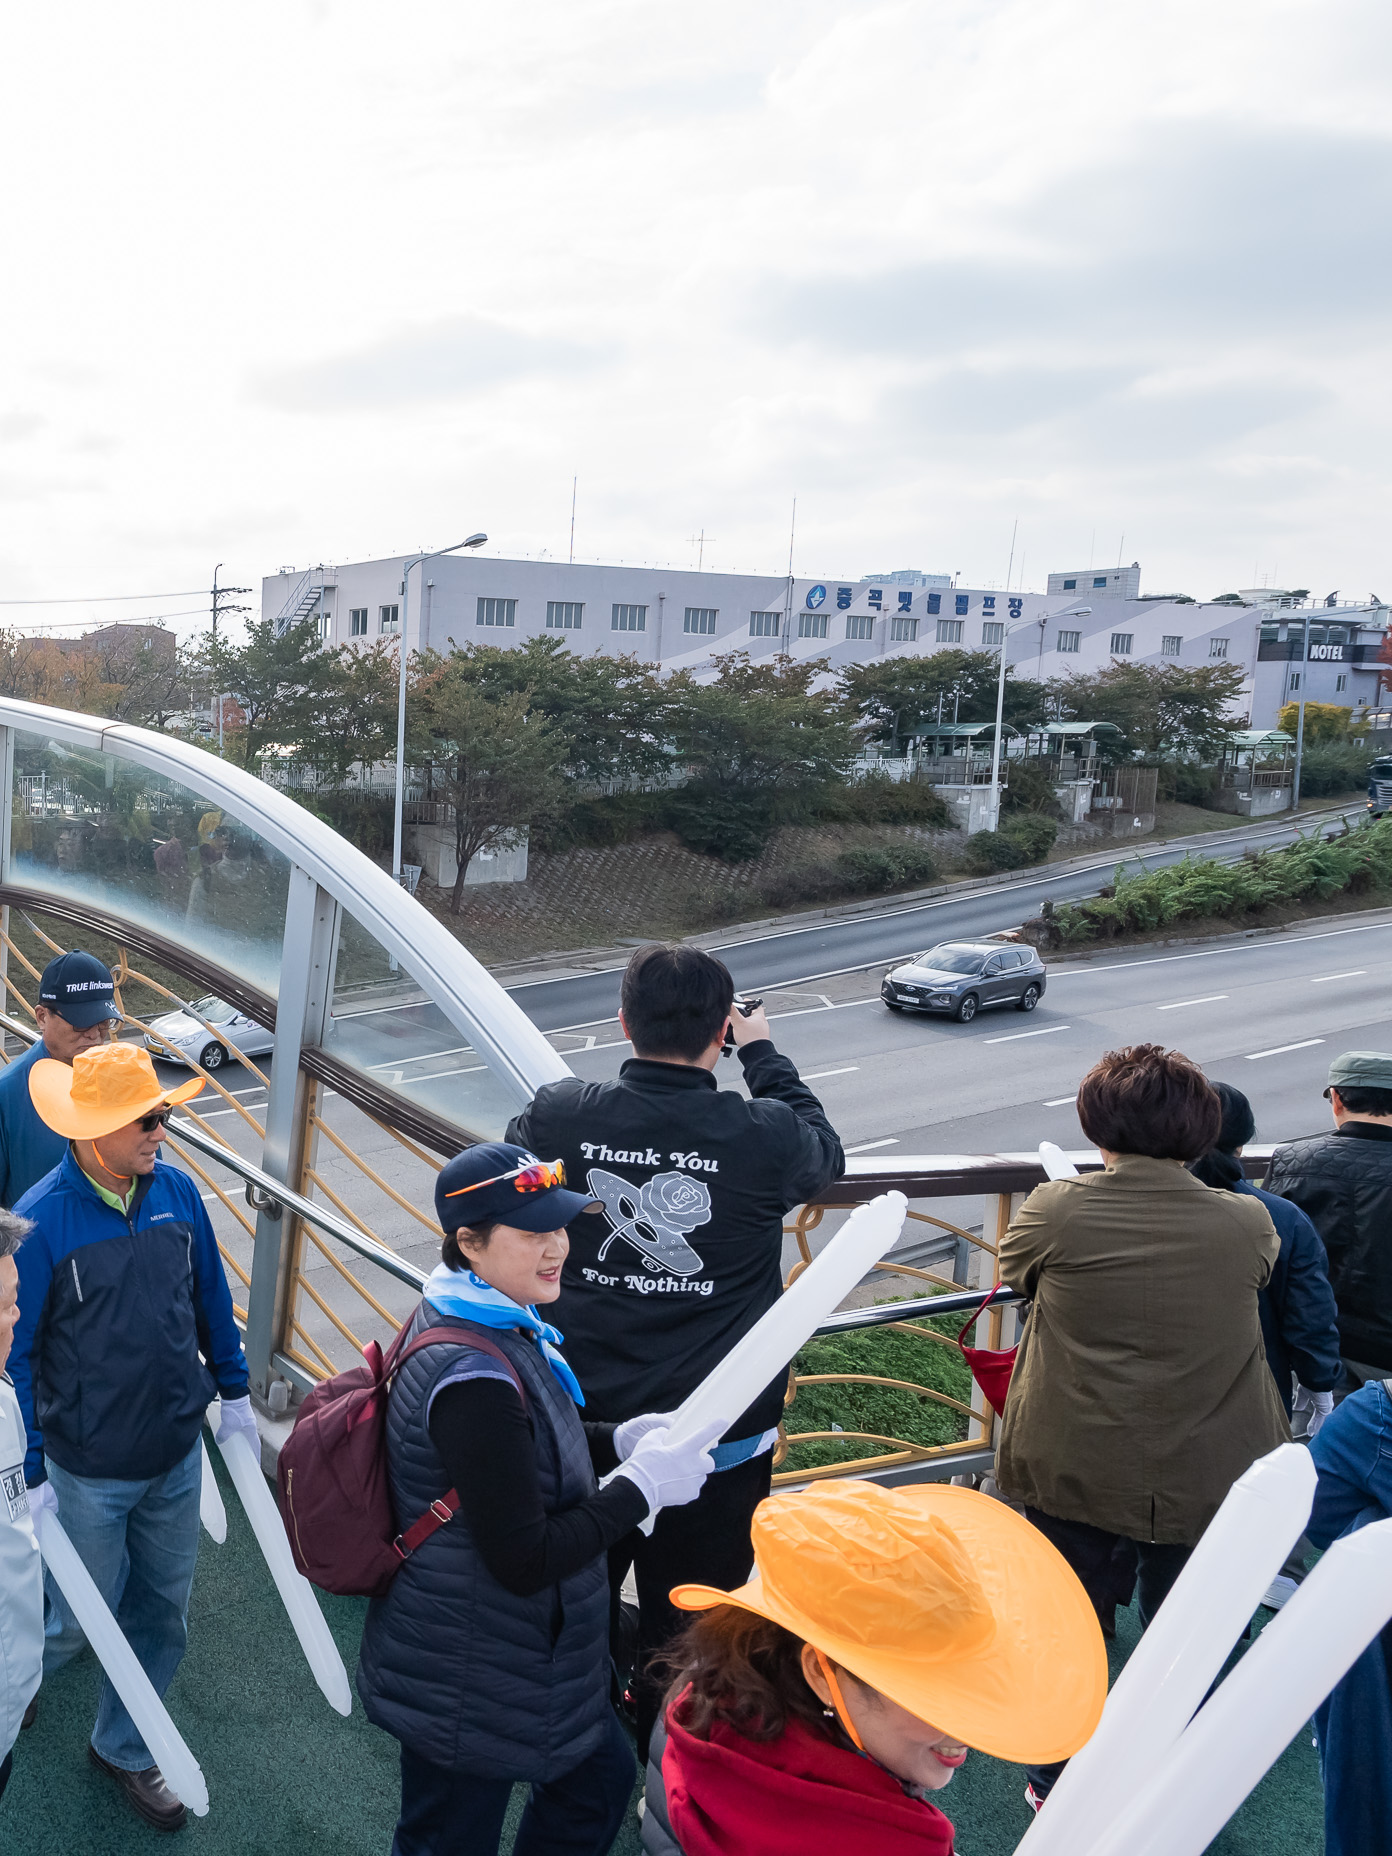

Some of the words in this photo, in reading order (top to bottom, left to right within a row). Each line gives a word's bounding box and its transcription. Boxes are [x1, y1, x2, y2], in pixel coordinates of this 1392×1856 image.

[66, 982, 88, 993] TRUE
[580, 1142, 661, 1166] Thank
[669, 1151, 719, 1173] You
[581, 1267, 620, 1287] For
[624, 1275, 714, 1296] Nothing
